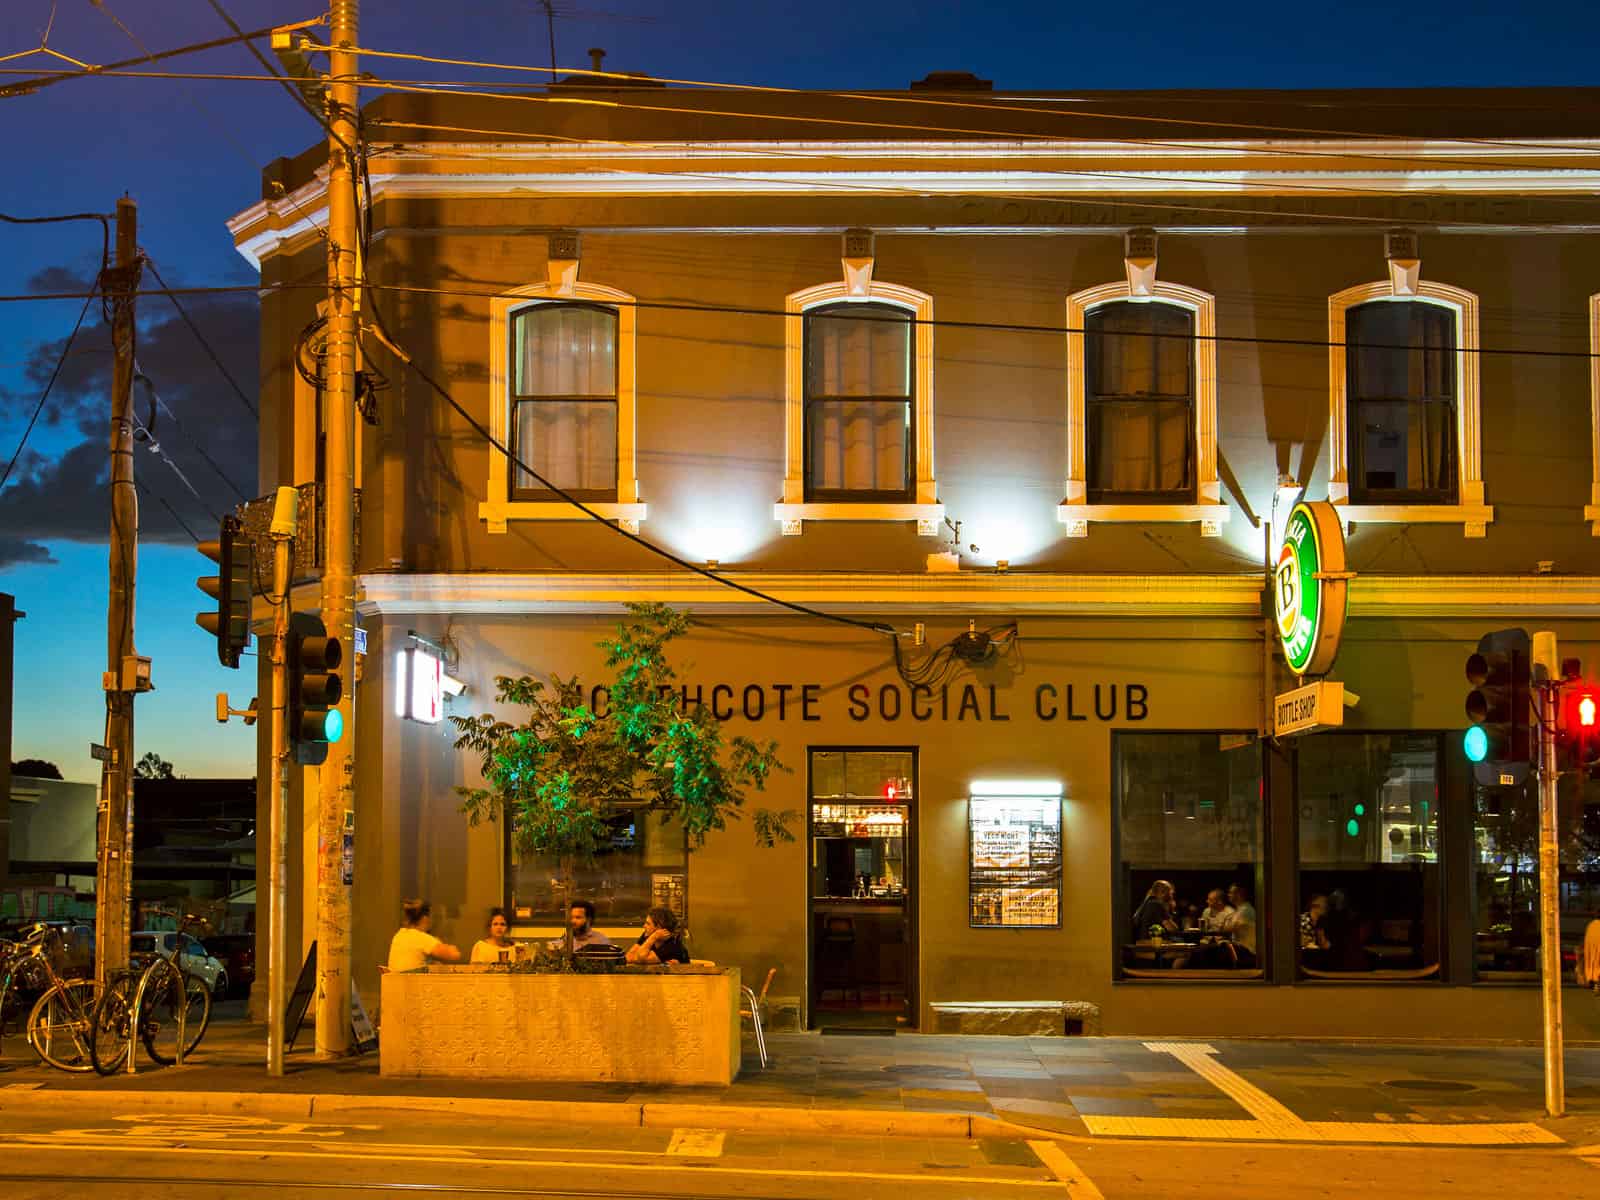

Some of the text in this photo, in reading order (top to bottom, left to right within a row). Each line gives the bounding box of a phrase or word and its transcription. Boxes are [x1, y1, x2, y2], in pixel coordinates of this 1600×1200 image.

[563, 683, 1149, 722] OTHCOTE SOCIAL CLUB
[1277, 694, 1316, 727] BOTTLE SHOP
